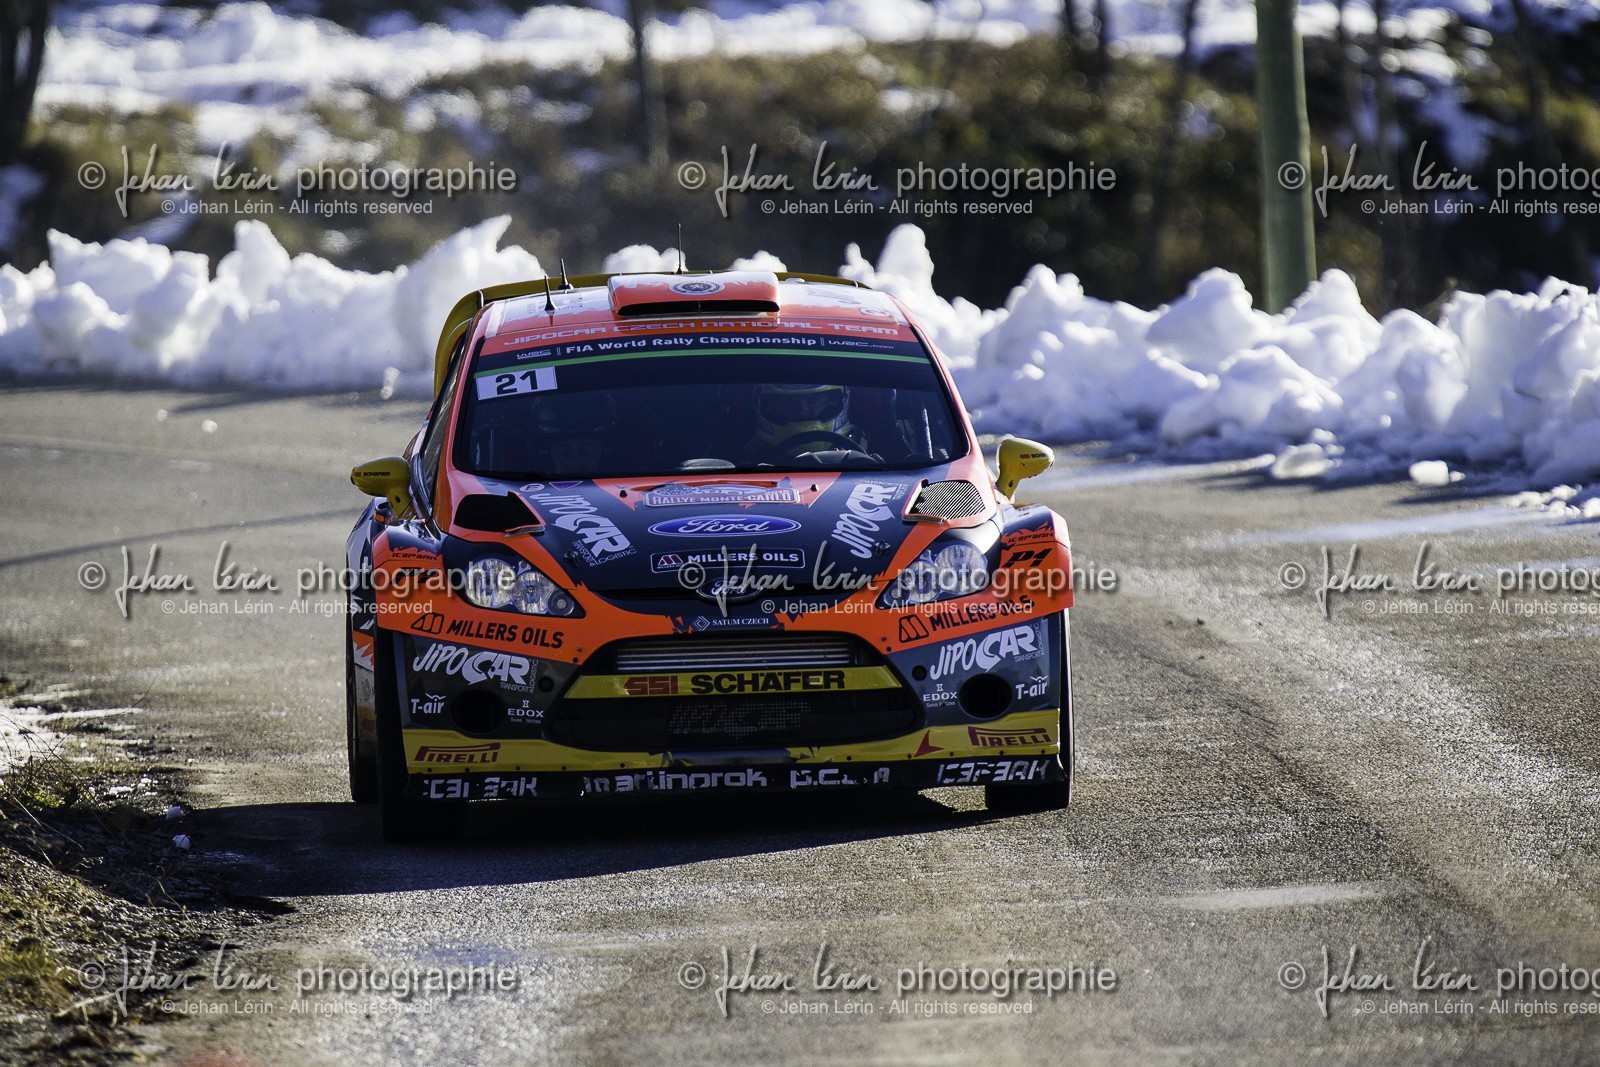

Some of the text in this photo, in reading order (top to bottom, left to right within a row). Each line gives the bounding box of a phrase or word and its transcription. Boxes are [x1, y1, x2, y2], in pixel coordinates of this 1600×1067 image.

[565, 344, 594, 354] FIA
[598, 338, 647, 350] World
[652, 337, 694, 348] Rally
[700, 335, 817, 347] Championship
[494, 369, 539, 397] 21
[652, 495, 696, 505] RALLYE
[678, 516, 770, 534] Ford
[687, 551, 800, 564] MILLERS OILS
[1002, 547, 1053, 568] P1
[928, 603, 997, 632] MILLERS
[446, 619, 564, 650] MILLERS OILS
[623, 669, 846, 696] SSI SCHÄFER
[1015, 679, 1048, 700] T-air
[410, 698, 446, 714] T-air
[922, 691, 958, 702] EDOX
[507, 707, 545, 718] EDOX
[967, 725, 1052, 748] PIRELLI
[413, 742, 501, 764] PIRELLI
